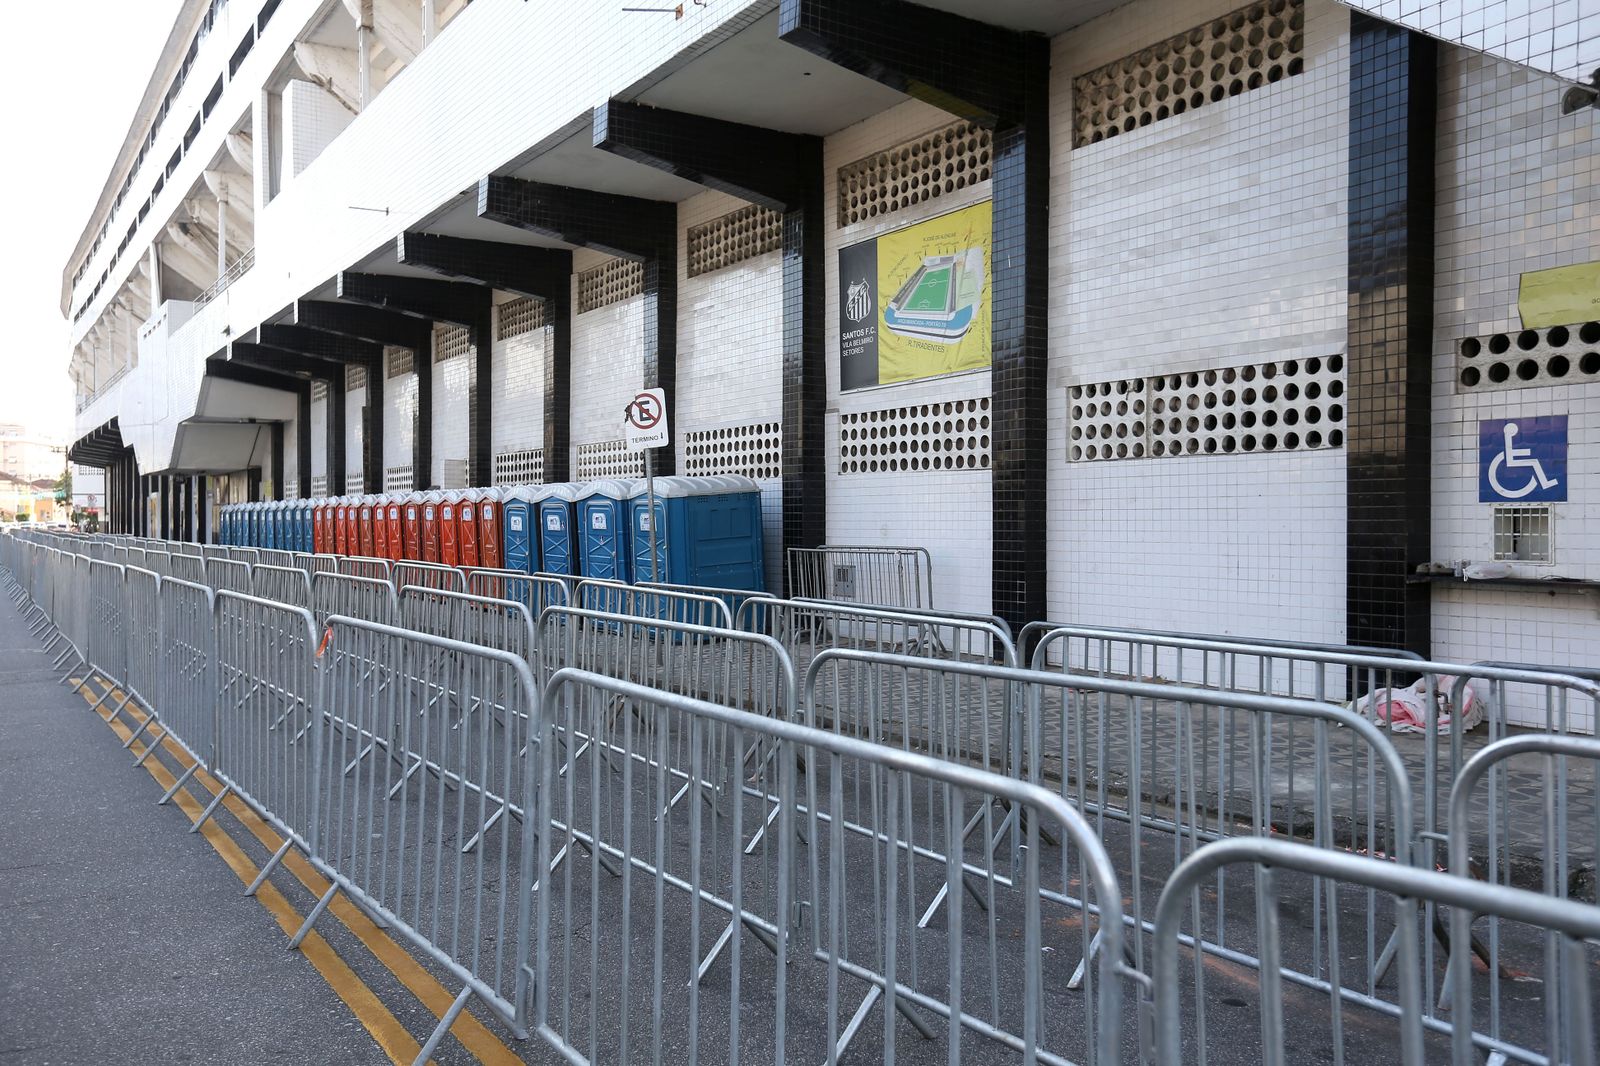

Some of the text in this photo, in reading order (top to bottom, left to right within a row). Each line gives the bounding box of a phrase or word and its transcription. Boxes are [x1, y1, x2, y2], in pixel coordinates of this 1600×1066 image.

[842, 326, 877, 341] SANTOS F.C.
[842, 336, 874, 349] VILA BELMIRO
[842, 347, 864, 357] SETORES
[639, 400, 652, 421] E
